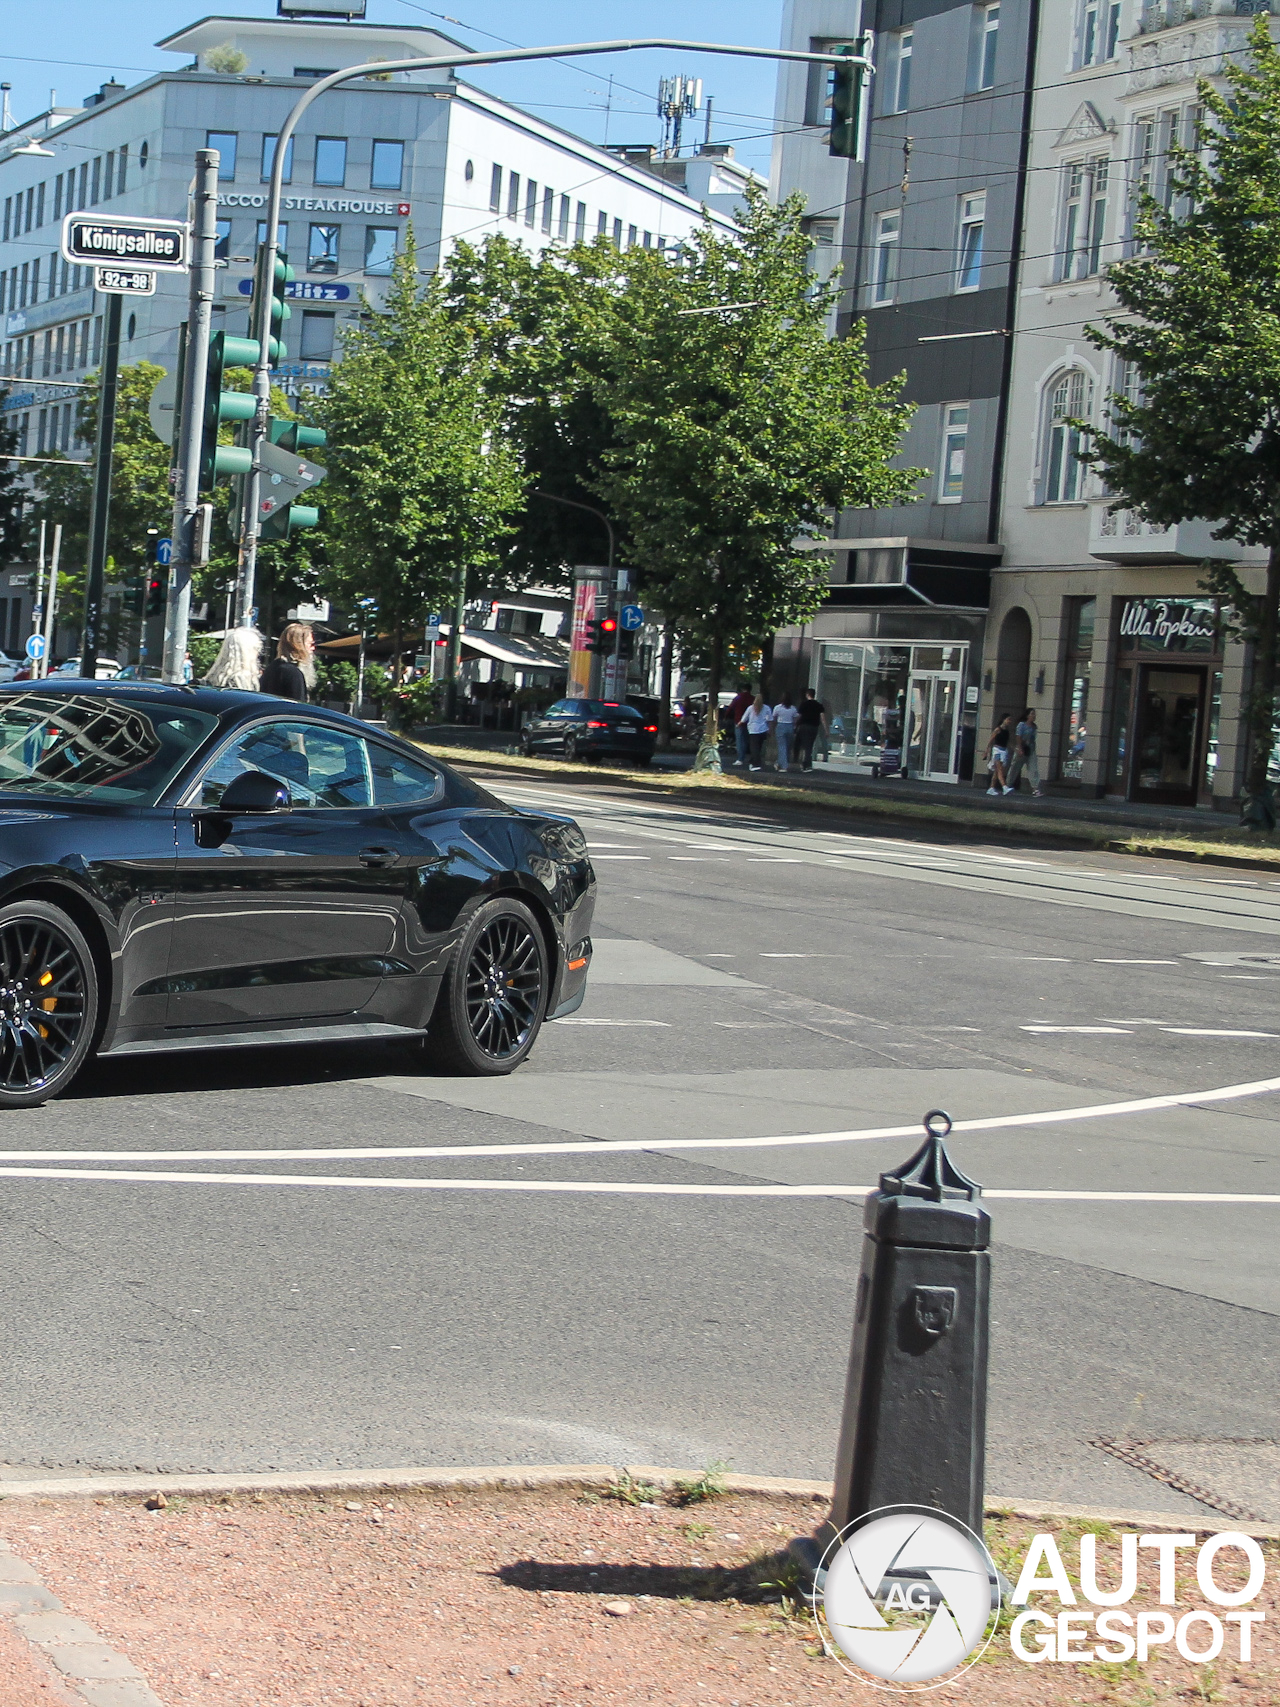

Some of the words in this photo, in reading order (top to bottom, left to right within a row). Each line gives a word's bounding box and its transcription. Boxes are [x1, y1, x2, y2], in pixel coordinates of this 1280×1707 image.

[285, 198, 394, 215] STEAKHOUSE
[81, 226, 175, 255] Königsallee
[104, 271, 148, 289] 92a-98
[250, 281, 338, 299] rlitz
[1120, 602, 1151, 635] Ulla
[1152, 603, 1214, 647] Popken
